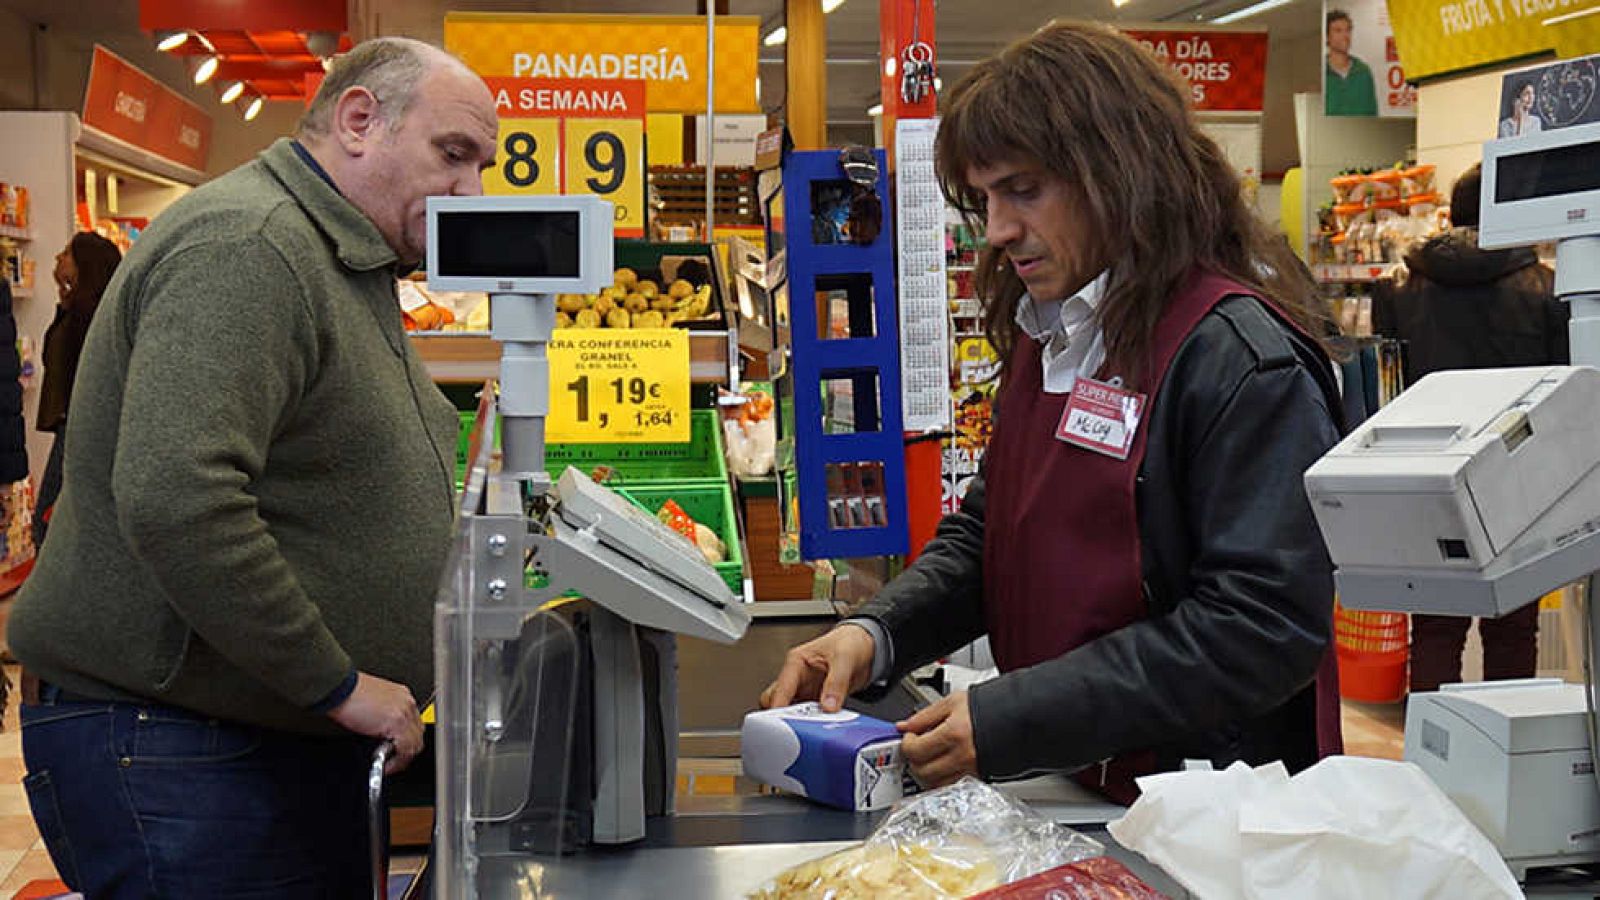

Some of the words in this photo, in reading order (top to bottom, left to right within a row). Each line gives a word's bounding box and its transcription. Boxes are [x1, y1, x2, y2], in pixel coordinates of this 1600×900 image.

[1440, 0, 1493, 35] FRUTA
[1494, 0, 1505, 22] Y
[1176, 36, 1213, 59] DÍA
[513, 47, 690, 80] PANADERÍA
[519, 90, 628, 111] SEMANA
[504, 131, 539, 187] 8
[584, 131, 626, 194] 9
[579, 339, 672, 349] CONFERENCIA
[580, 352, 633, 361] GRANEL
